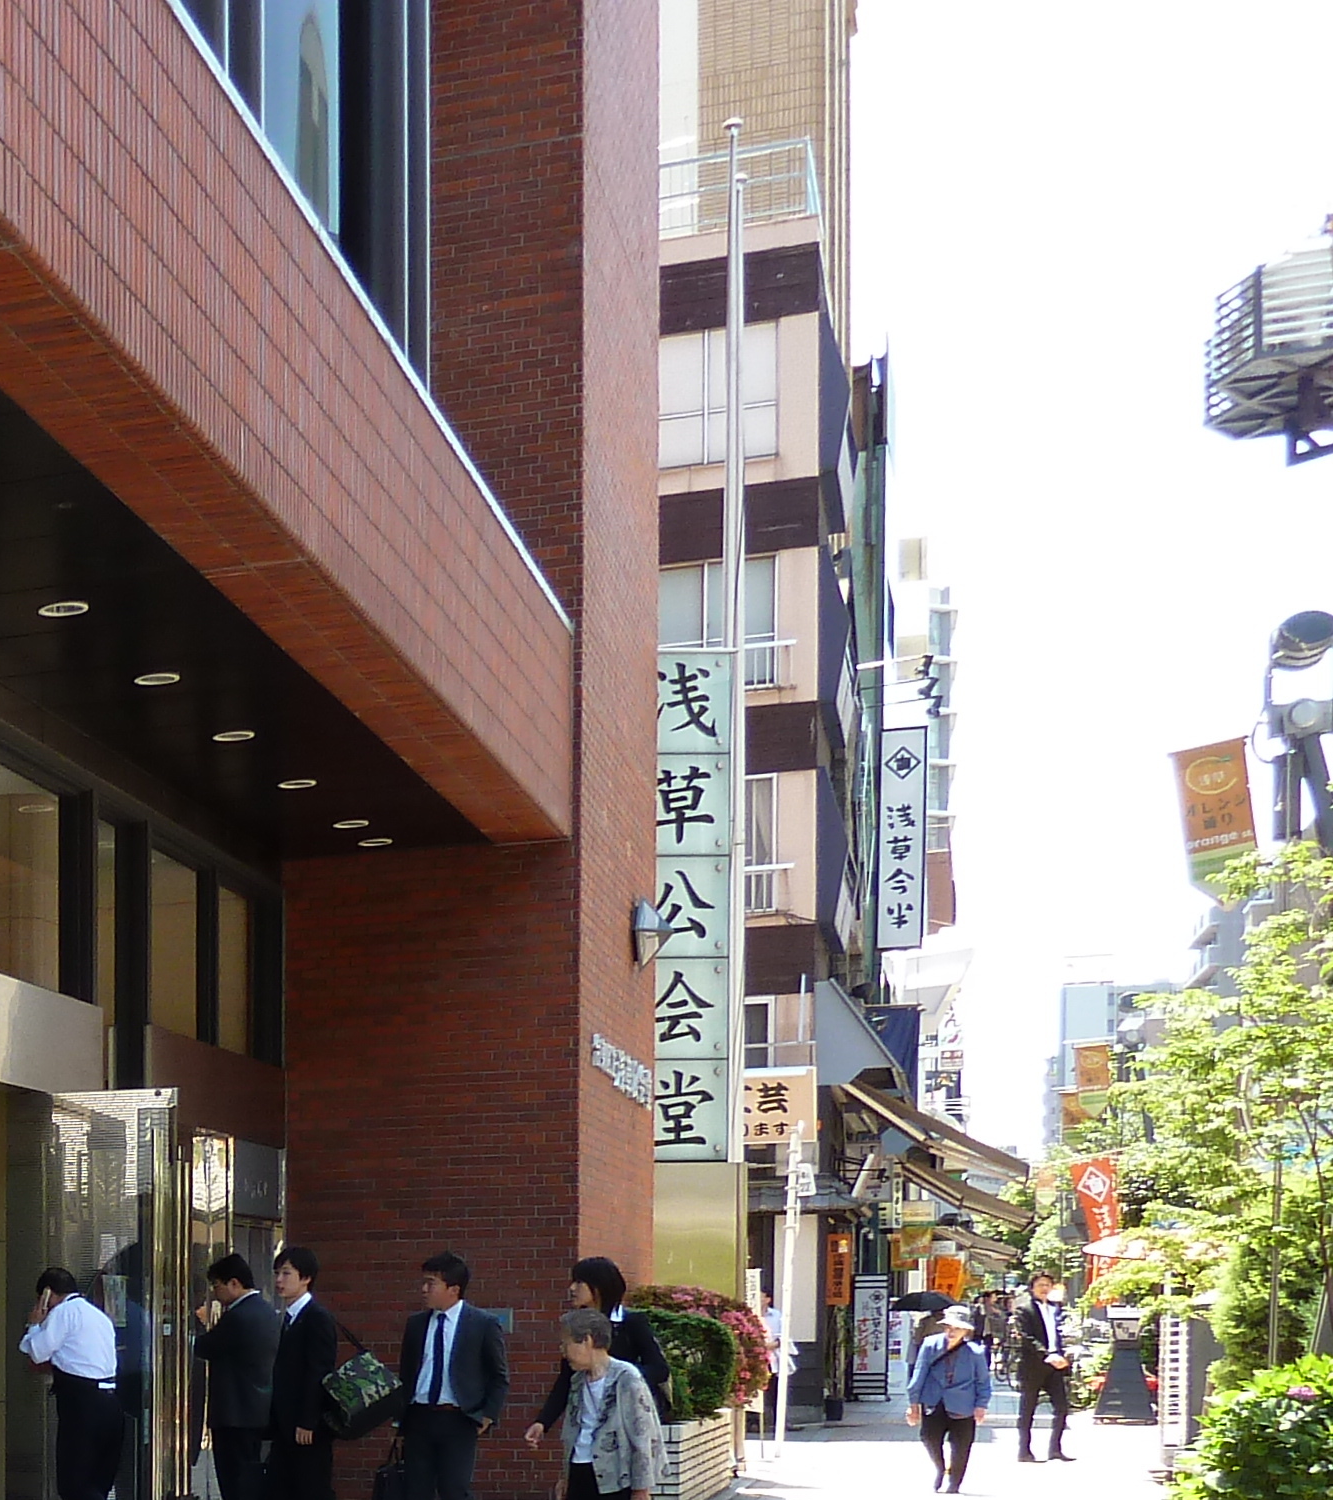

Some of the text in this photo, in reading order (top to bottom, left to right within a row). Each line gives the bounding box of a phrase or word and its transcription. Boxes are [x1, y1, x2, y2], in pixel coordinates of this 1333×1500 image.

[884, 803, 916, 929] 浅草今半
[1186, 830, 1239, 850] orange
[654, 661, 717, 1146] 浅草公会堂
